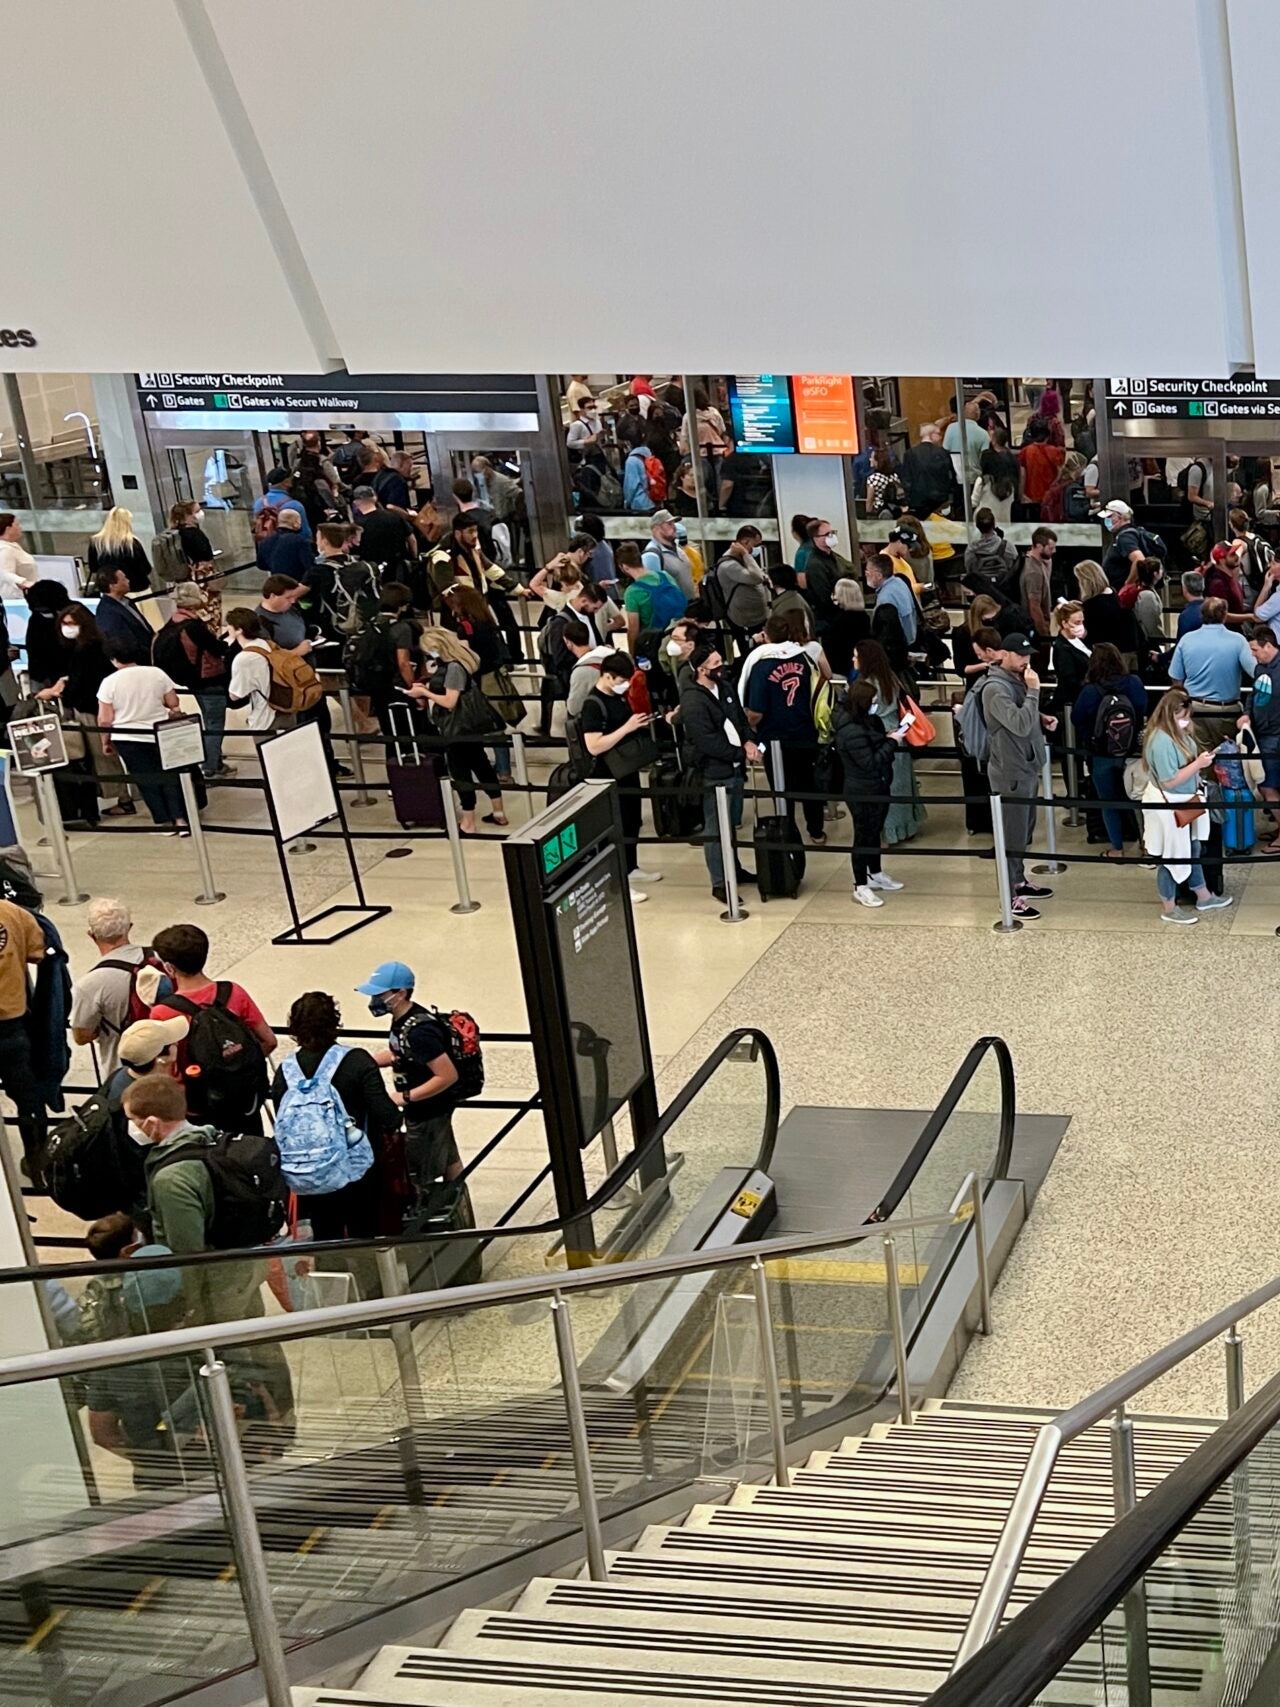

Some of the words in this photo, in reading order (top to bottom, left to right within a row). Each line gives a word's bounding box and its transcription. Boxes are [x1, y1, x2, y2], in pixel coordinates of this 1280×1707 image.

[0, 329, 37, 348] es
[174, 374, 221, 388] Security
[222, 374, 284, 388] Checkpoint
[1149, 380, 1199, 395] Security
[1201, 380, 1268, 395] Checkpoint
[802, 387, 828, 396] @SFO
[177, 396, 205, 406] Gates
[242, 396, 271, 407] Gates
[271, 397, 285, 407] via
[285, 396, 318, 407] Secure
[318, 397, 359, 410] Walkway
[1148, 403, 1178, 414] Gates
[1220, 404, 1250, 414] Gates
[1250, 404, 1266, 414] via
[782, 676, 800, 707] 7
[13, 726, 44, 737] REAL
[43, 723, 56, 731] ID
